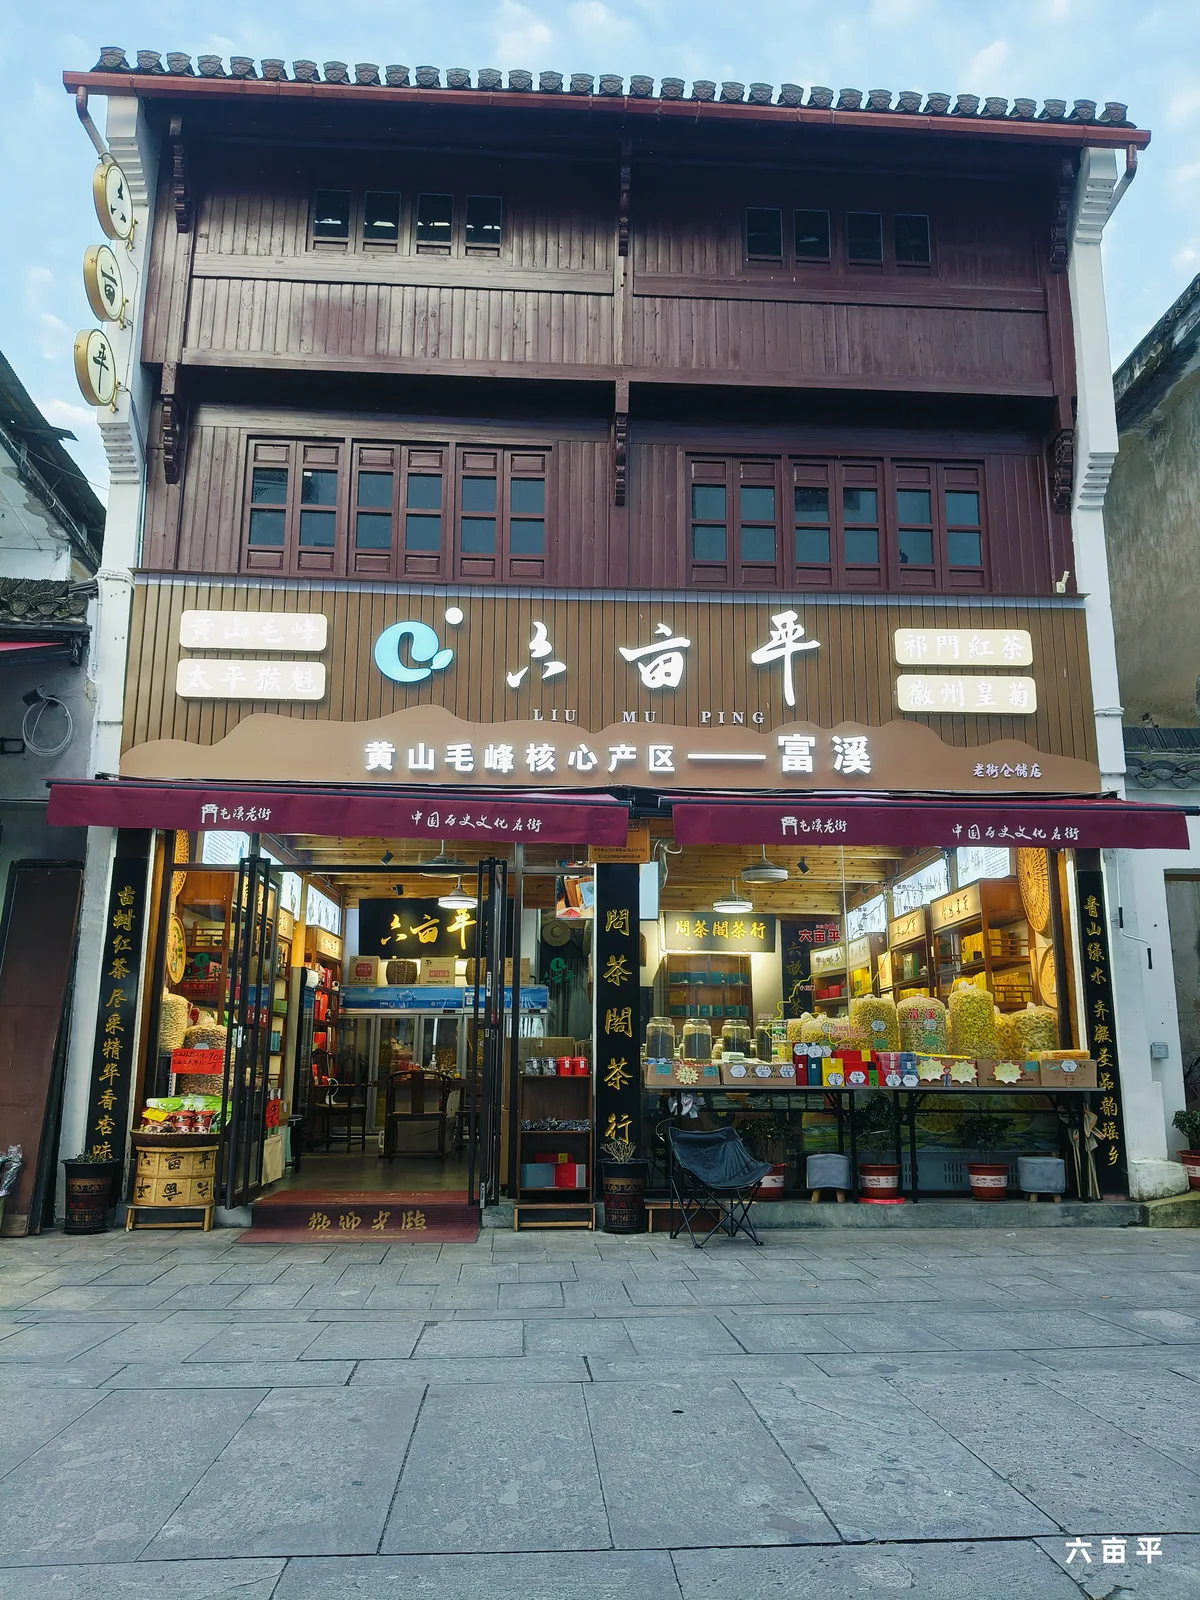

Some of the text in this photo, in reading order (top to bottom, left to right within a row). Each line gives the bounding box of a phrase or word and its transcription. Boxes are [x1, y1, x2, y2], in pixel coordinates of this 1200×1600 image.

[188, 616, 320, 645] 黄山毛峰
[506, 610, 821, 707] 六亩平
[903, 634, 1026, 661] 祁門紅茶
[184, 663, 318, 693] 太平猴魁
[908, 682, 1031, 709] 徽州皇菊
[533, 708, 766, 725] LIU MU PING
[972, 761, 1043, 779] 老街仓储店
[411, 810, 543, 833] 中国历史文化名街
[952, 823, 1080, 842] 中国历史文化名街
[380, 908, 477, 951] 六亩平
[798, 929, 841, 943] 六亩平
